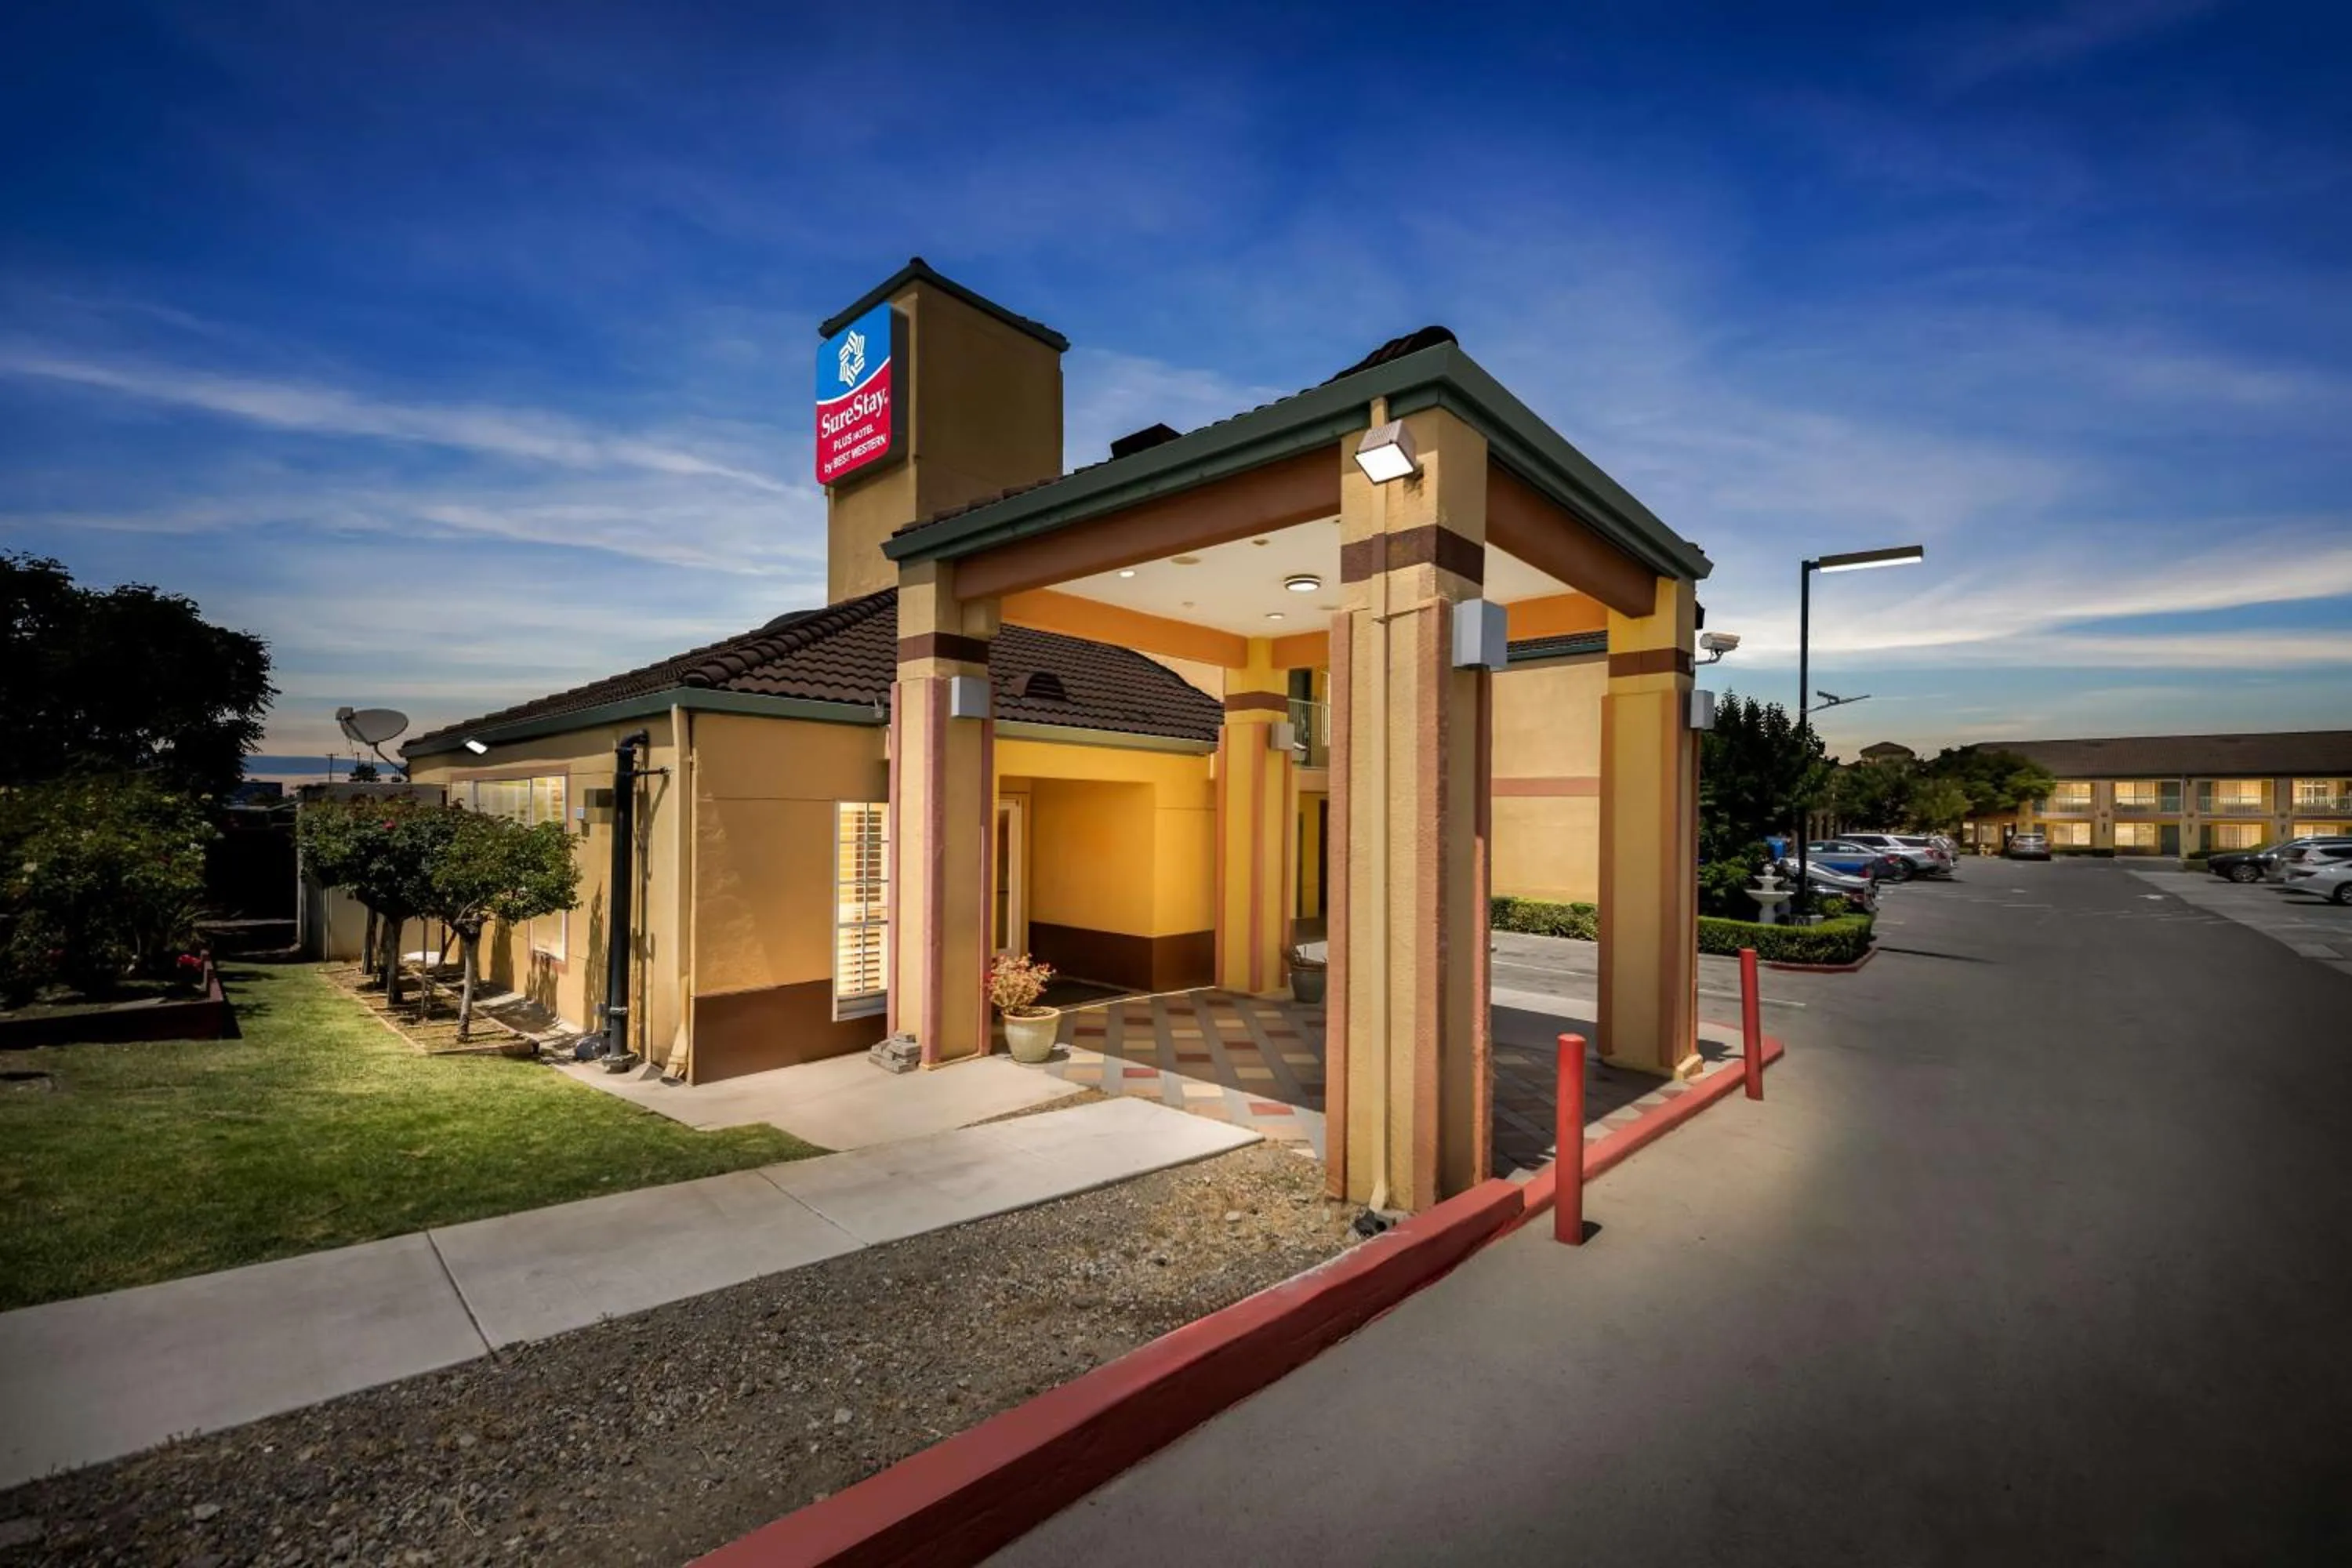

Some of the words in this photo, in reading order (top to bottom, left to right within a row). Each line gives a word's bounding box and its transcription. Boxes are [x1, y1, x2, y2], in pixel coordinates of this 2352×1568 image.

[824, 463, 832, 474] by
[833, 450, 851, 468] BEST
[851, 434, 887, 458] WESTERN
[833, 433, 852, 452] PLUS
[853, 423, 874, 441] HOTEL
